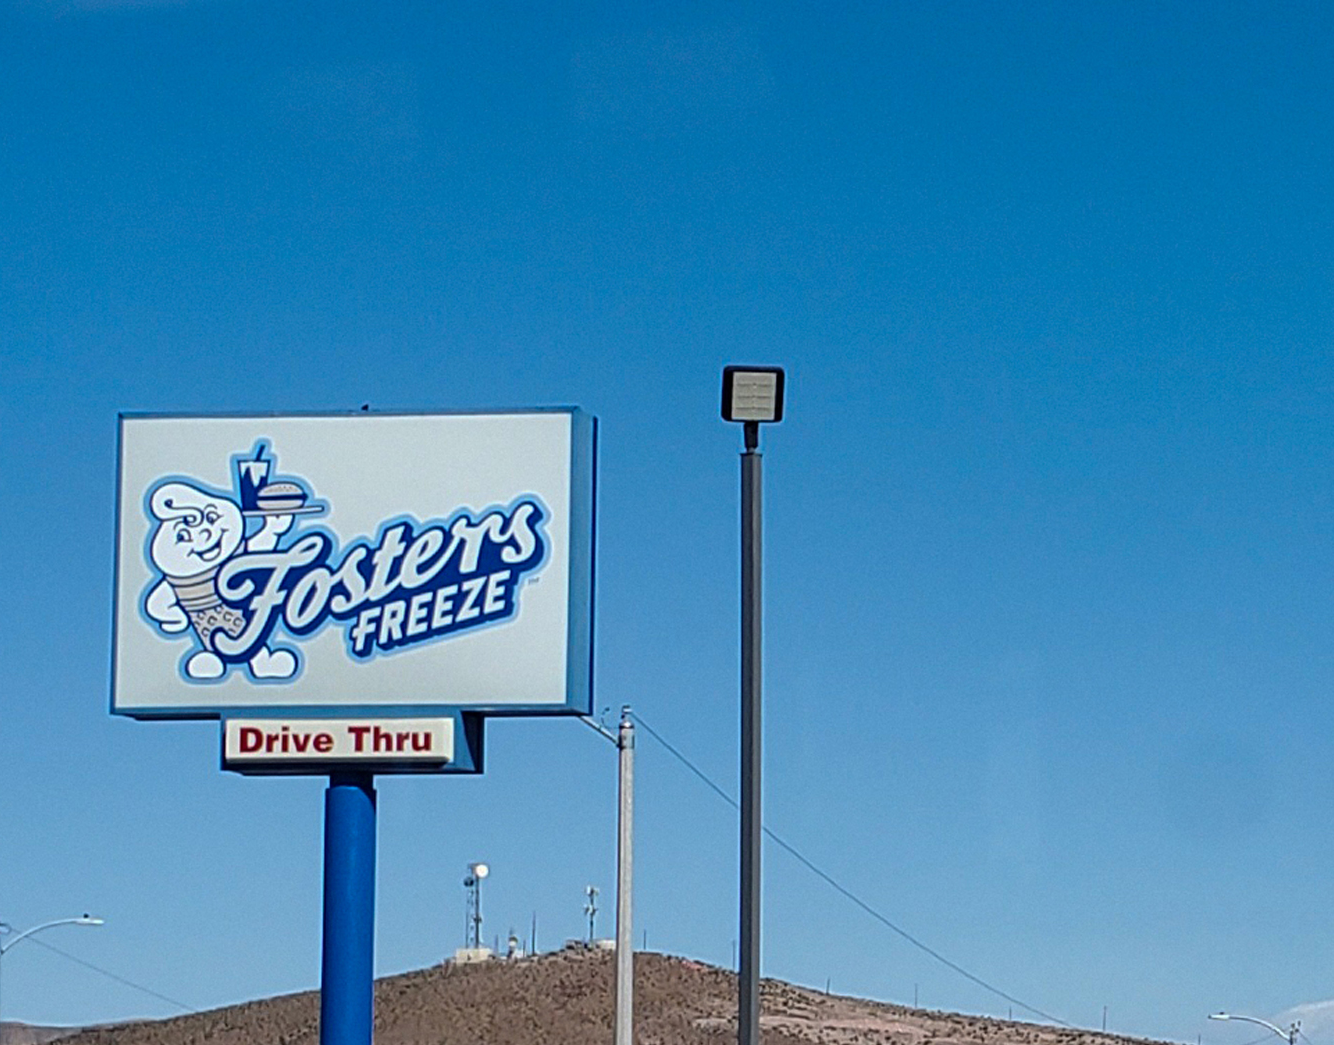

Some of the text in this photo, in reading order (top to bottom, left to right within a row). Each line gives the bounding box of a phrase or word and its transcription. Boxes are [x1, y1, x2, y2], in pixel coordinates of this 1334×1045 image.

[213, 500, 539, 656] Fosters
[351, 569, 511, 653] FREEZE
[238, 725, 433, 755] Drive Thru
